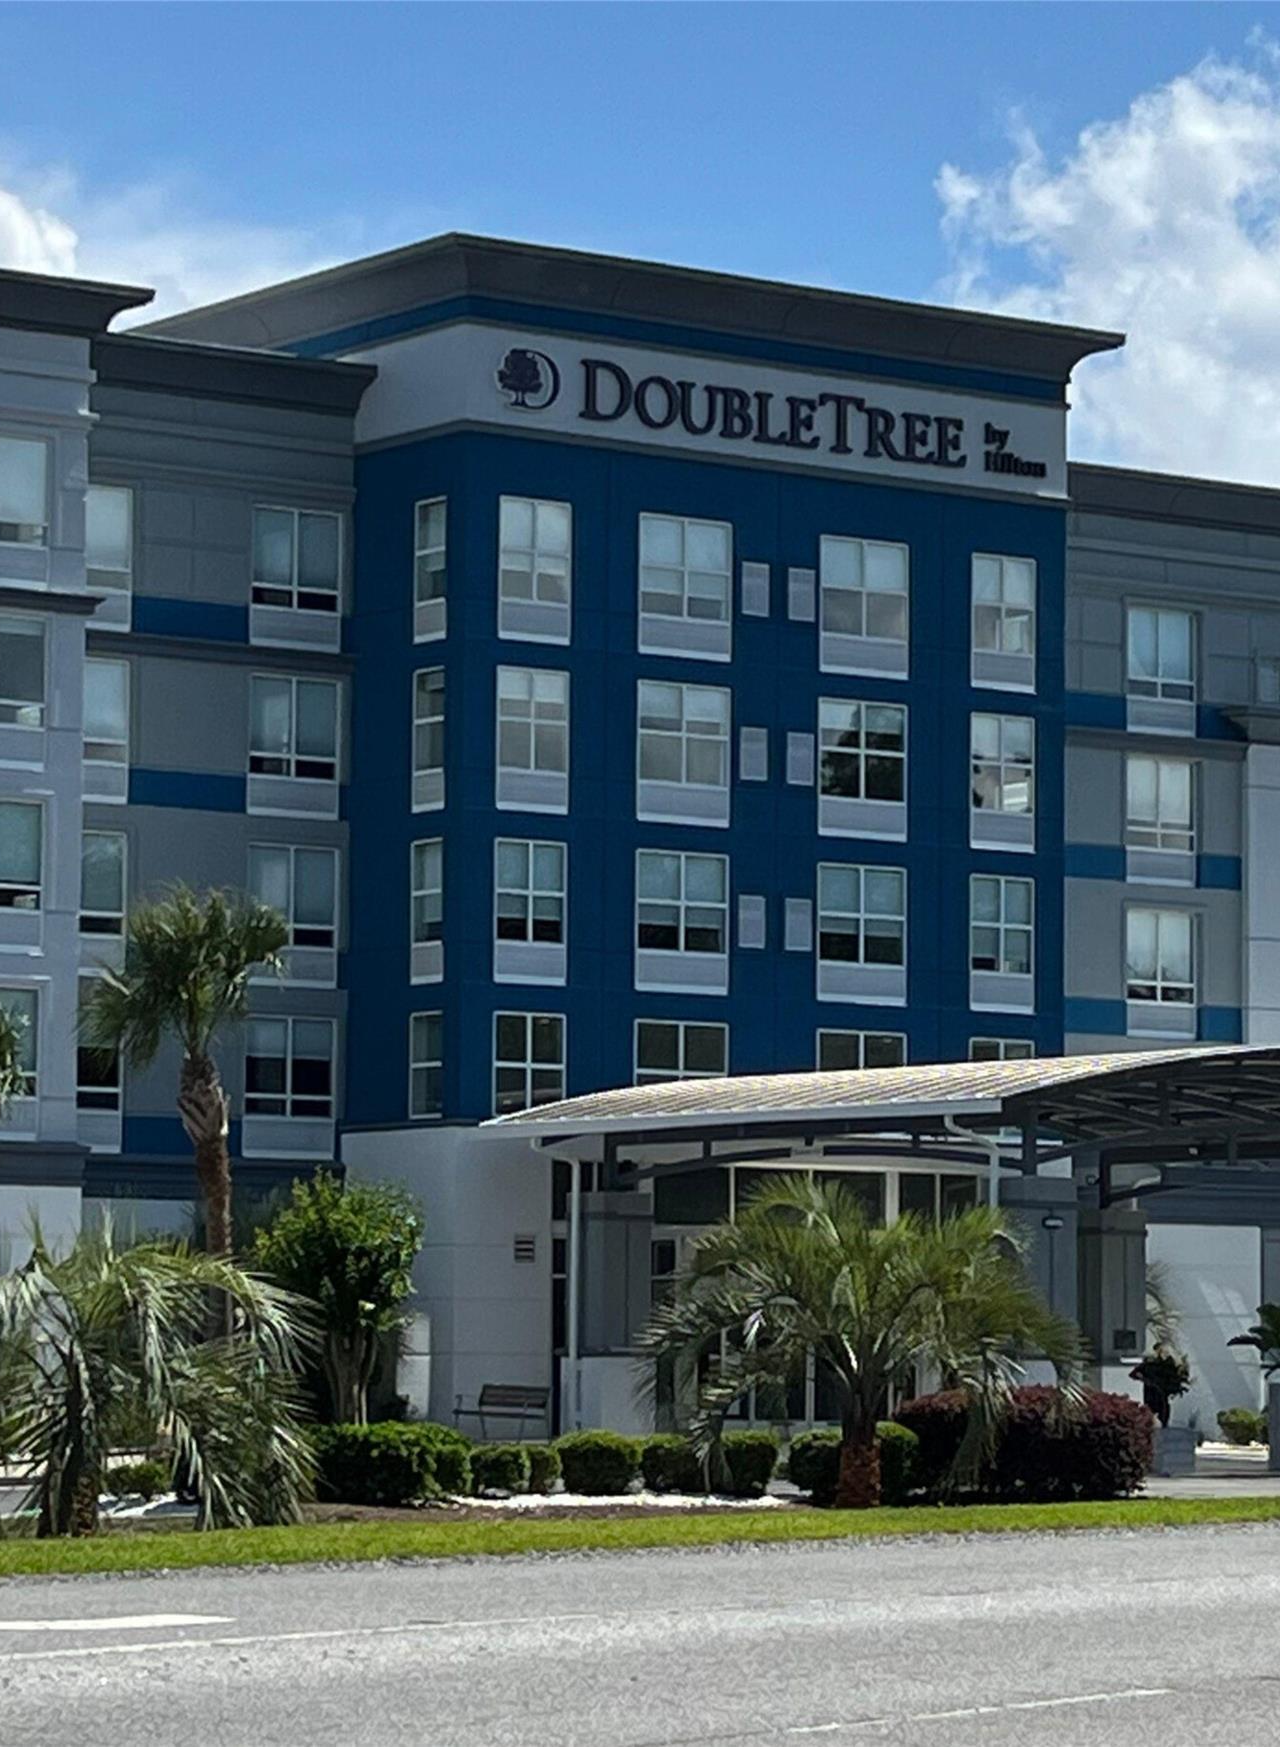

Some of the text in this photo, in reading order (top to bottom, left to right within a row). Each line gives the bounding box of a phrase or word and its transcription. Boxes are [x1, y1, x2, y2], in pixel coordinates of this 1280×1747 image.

[578, 358, 967, 468] DOUBLETREE
[984, 422, 1010, 451] by
[984, 450, 1046, 478] Hilton
